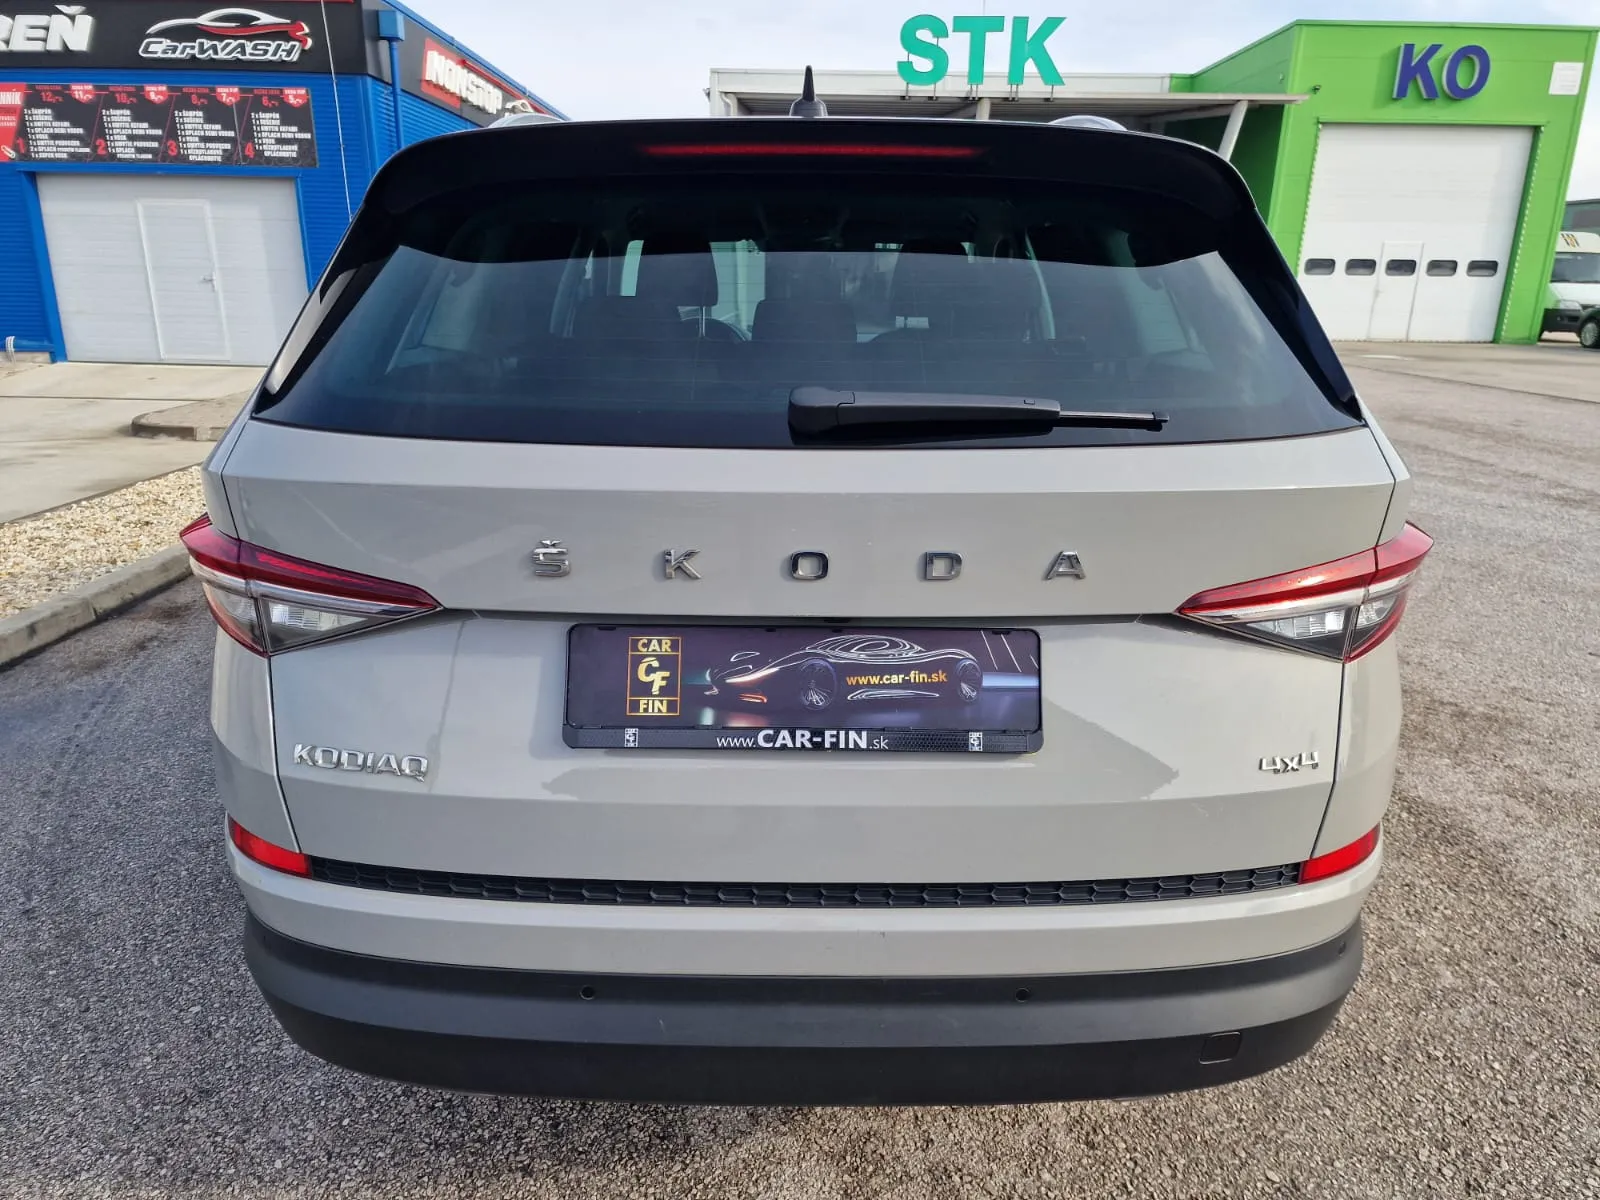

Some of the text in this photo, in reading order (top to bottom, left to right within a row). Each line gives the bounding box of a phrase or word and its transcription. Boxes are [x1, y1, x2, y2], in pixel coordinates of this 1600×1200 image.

[139, 38, 301, 62] CarWASH
[897, 14, 1067, 86] STK
[1392, 43, 1491, 100] KO
[96, 138, 107, 155] 2
[167, 140, 177, 156] 3
[244, 142, 255, 159] 4
[531, 539, 1087, 581] ŠKODA
[637, 638, 672, 652] CAR
[846, 669, 947, 686] www.car-fin.sk
[639, 700, 667, 713] FIN
[716, 729, 889, 750] www.CAR-FIN.sk
[294, 743, 428, 782] KODIAQ
[1259, 751, 1319, 774] 4x4
